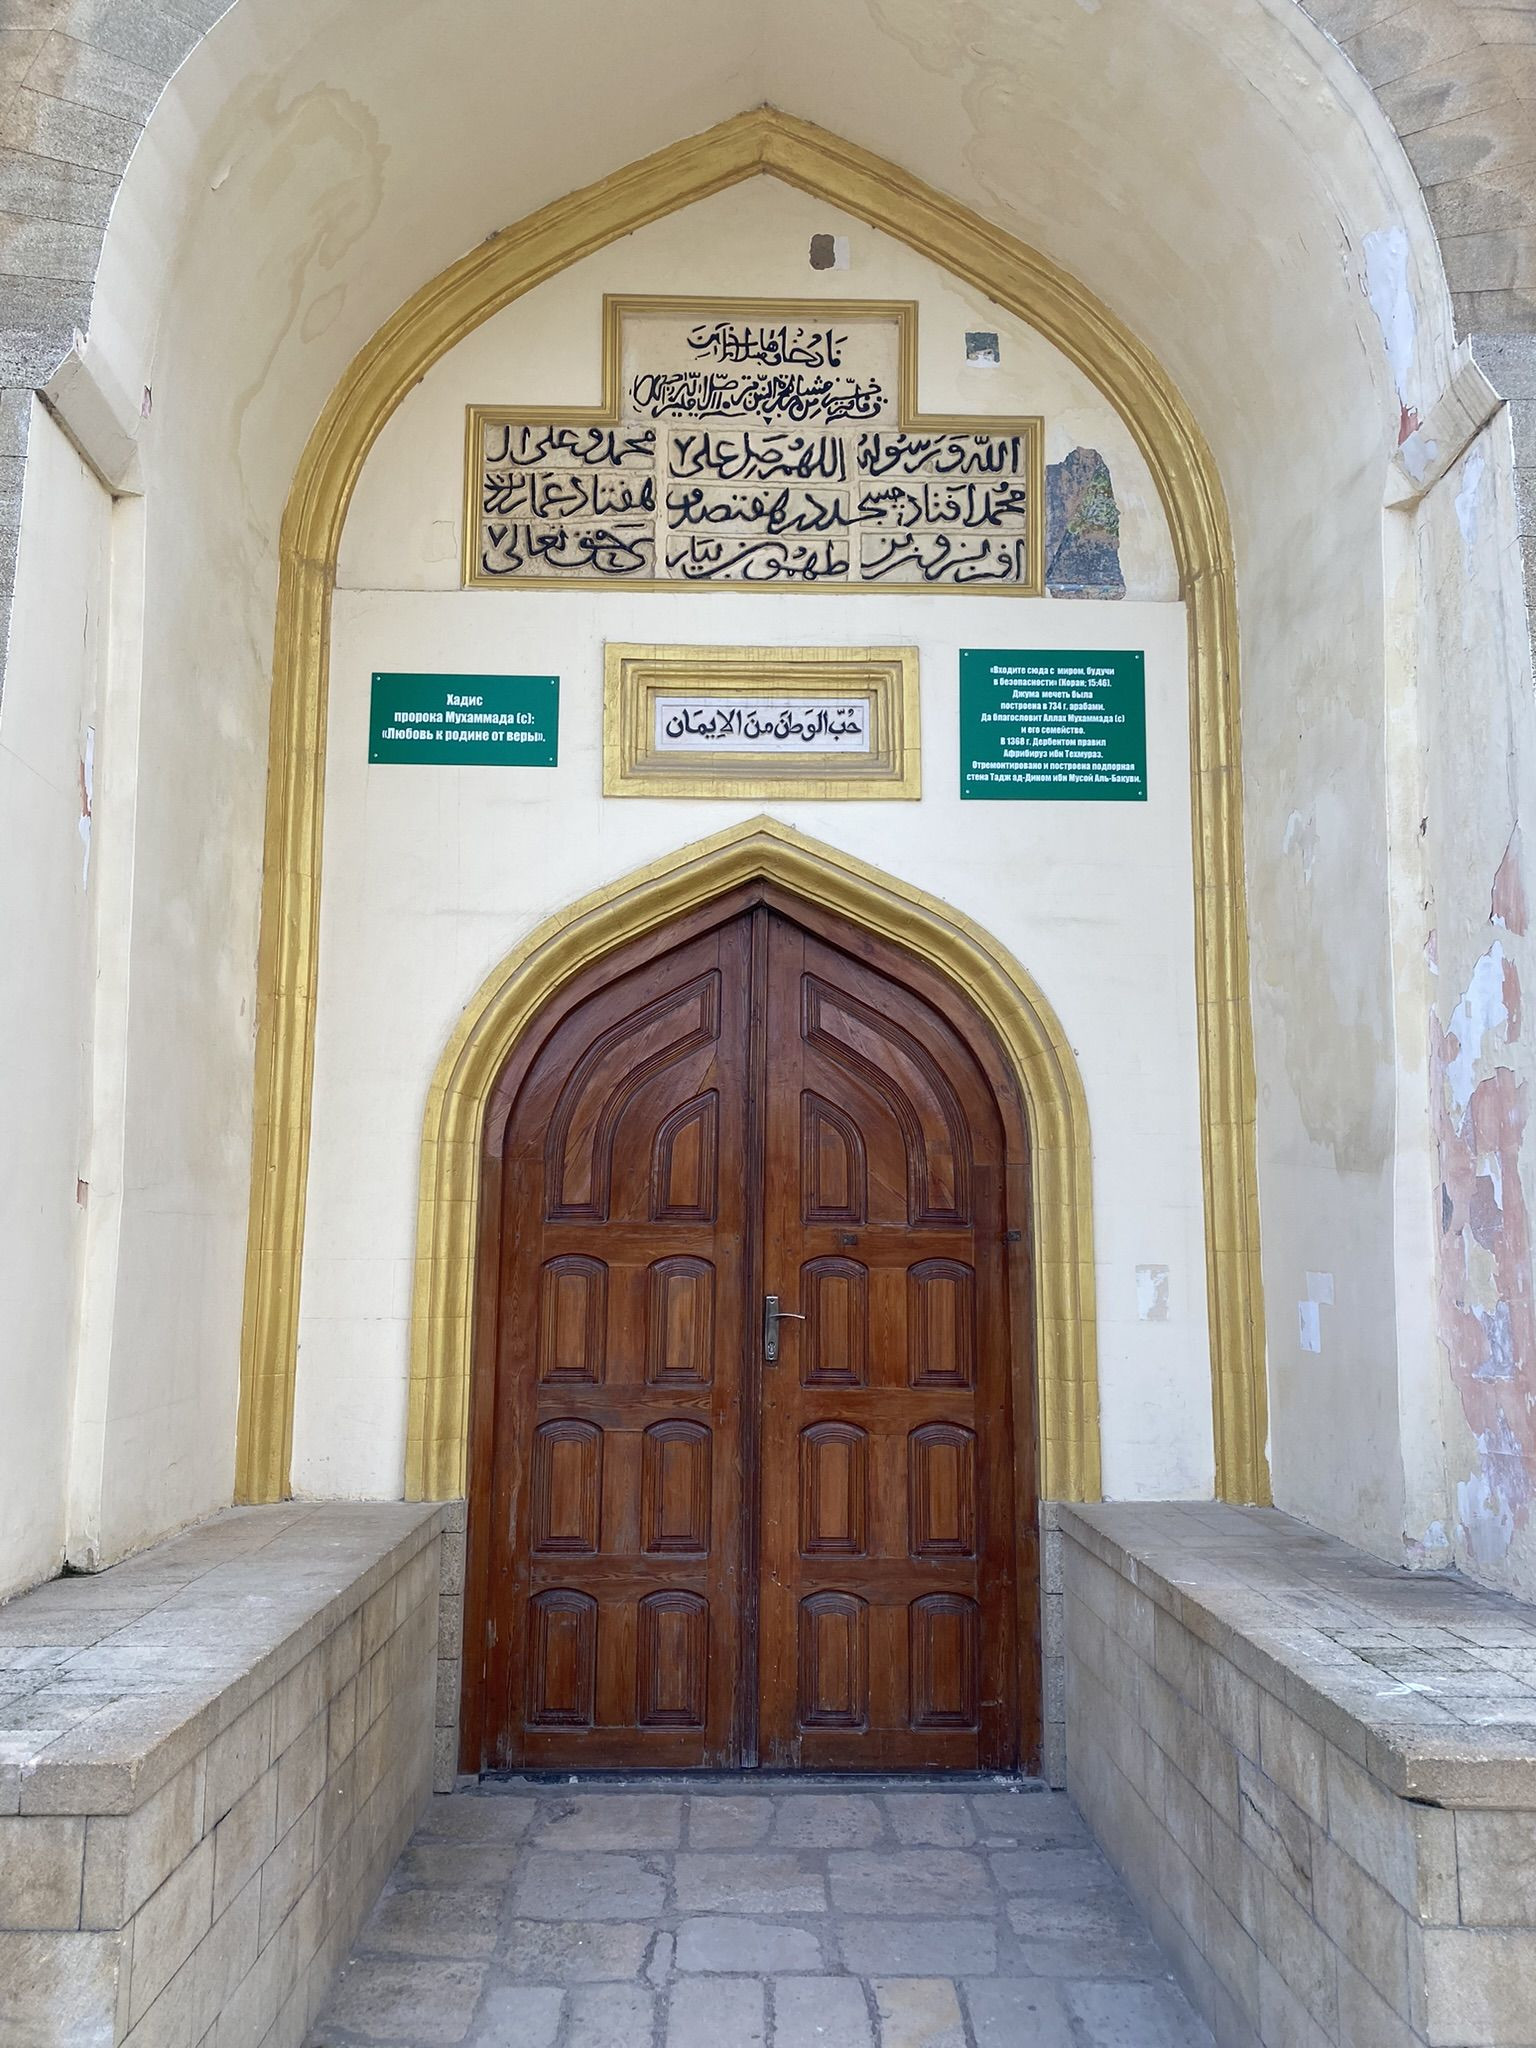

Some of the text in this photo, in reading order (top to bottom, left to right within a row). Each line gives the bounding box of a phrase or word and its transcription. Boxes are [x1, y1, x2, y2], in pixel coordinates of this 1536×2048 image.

[1086, 667, 1114, 676] будучи
[1012, 689, 1040, 699] Джума
[1072, 690, 1093, 699] была
[446, 694, 483, 707] Хадис
[1048, 702, 1062, 710] 734
[1069, 702, 1105, 711] арабами.
[394, 711, 535, 725] пророка Мухаммада (с):
[981, 713, 991, 722] Да
[993, 713, 1042, 722] благословит
[1043, 714, 1066, 722] Аллах
[1068, 714, 1114, 723] Мухаммада
[382, 727, 546, 743] «Любовь к родине от веры».
[1000, 737, 1006, 745] В
[1007, 737, 1025, 745] 1368
[1032, 737, 1077, 747] Дербентом
[1003, 749, 1103, 759] Африбируз ибн Техмураз.
[972, 761, 1042, 770] Отремонтировано
[1092, 763, 1135, 771] подпорная
[990, 773, 1011, 782] Тадж
[1012, 773, 1052, 782] ад-Дином
[1068, 774, 1093, 783] Мусой
[1094, 774, 1141, 783] Аль-Бакуви.
